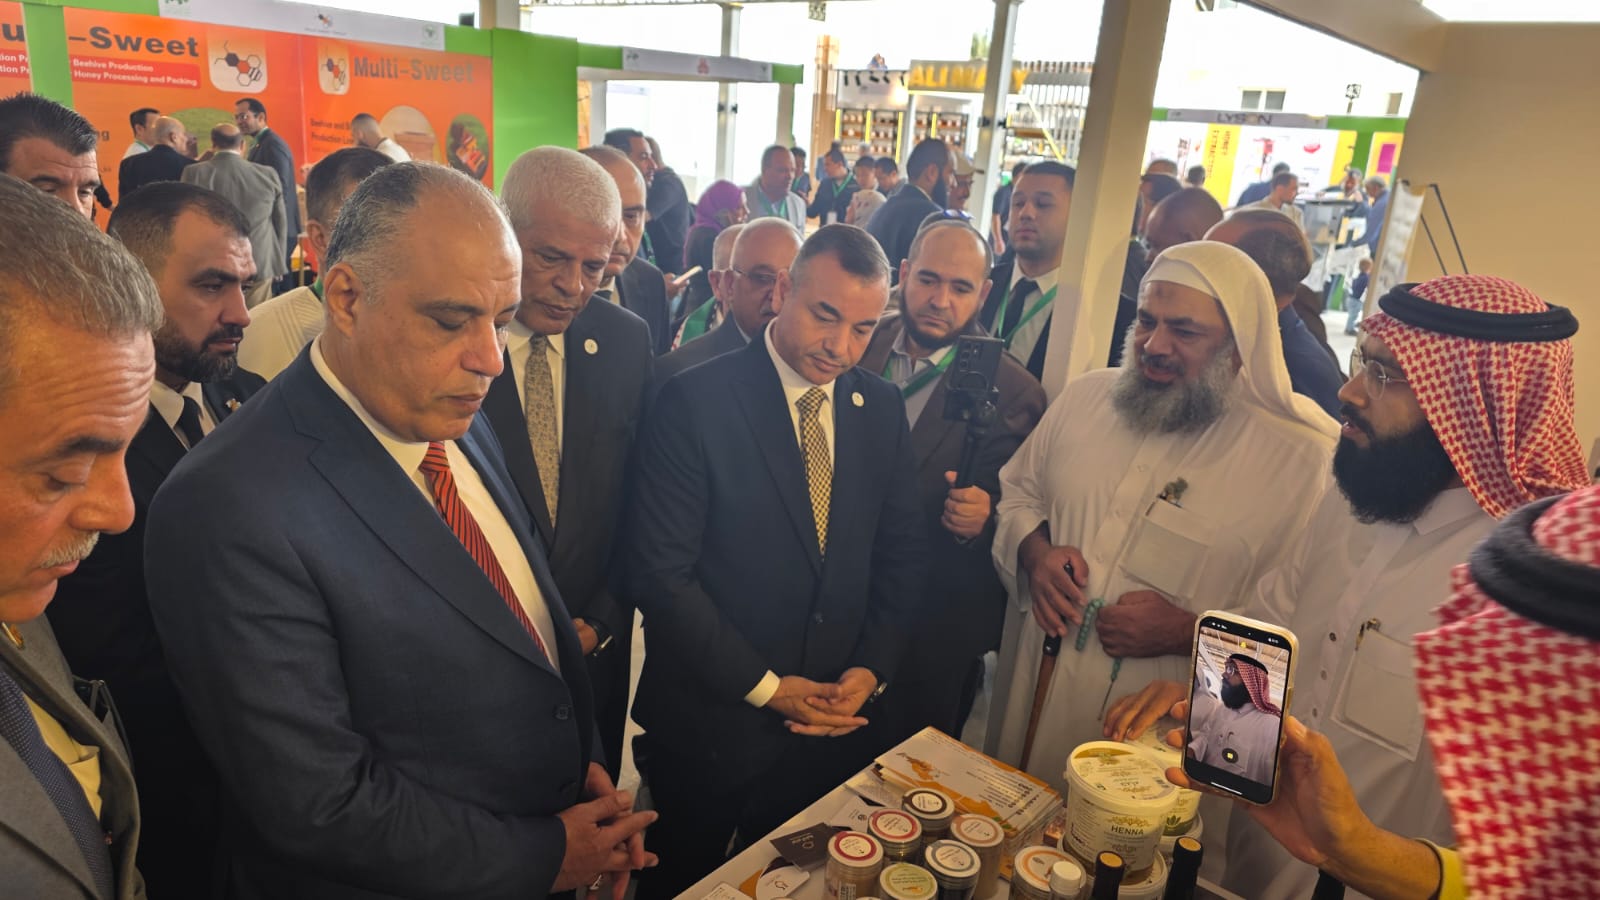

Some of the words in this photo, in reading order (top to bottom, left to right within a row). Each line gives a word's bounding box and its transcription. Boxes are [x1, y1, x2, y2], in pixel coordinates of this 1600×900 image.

[73, 58, 107, 69] Beehive
[108, 61, 154, 72] Production
[354, 58, 474, 81] Multi-Sweet
[74, 70, 101, 80] Honey
[103, 73, 148, 83] Processing
[166, 77, 198, 86] Packing
[1216, 112, 1273, 125] LYSON
[1111, 825, 1144, 836] HENNA
